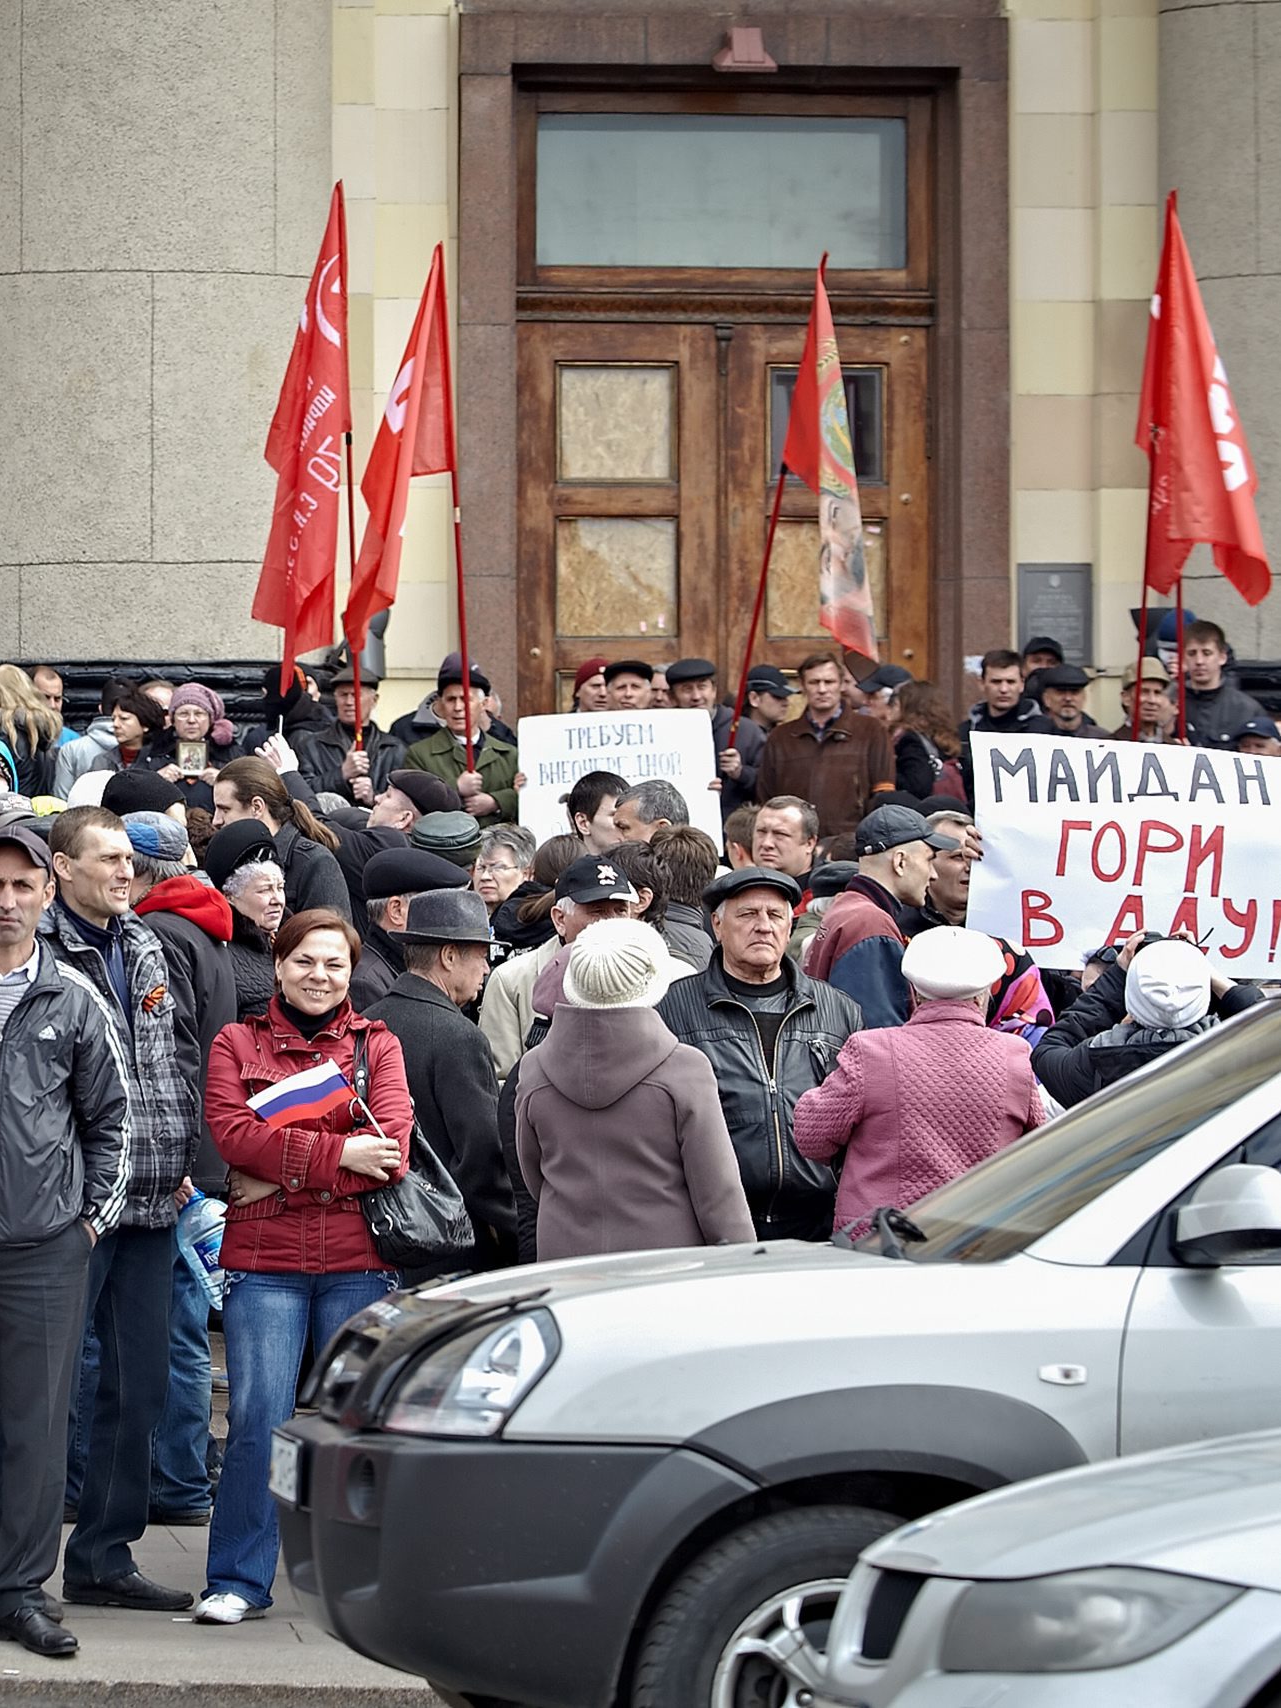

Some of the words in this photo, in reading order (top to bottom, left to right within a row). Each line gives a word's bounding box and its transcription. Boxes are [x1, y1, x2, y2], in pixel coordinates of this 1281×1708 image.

[564, 723, 655, 750] ТРЕБУЕМ
[989, 744, 1272, 806] МАЙДАН
[1055, 819, 1225, 898] ГОРИ
[1021, 889, 1064, 948] В
